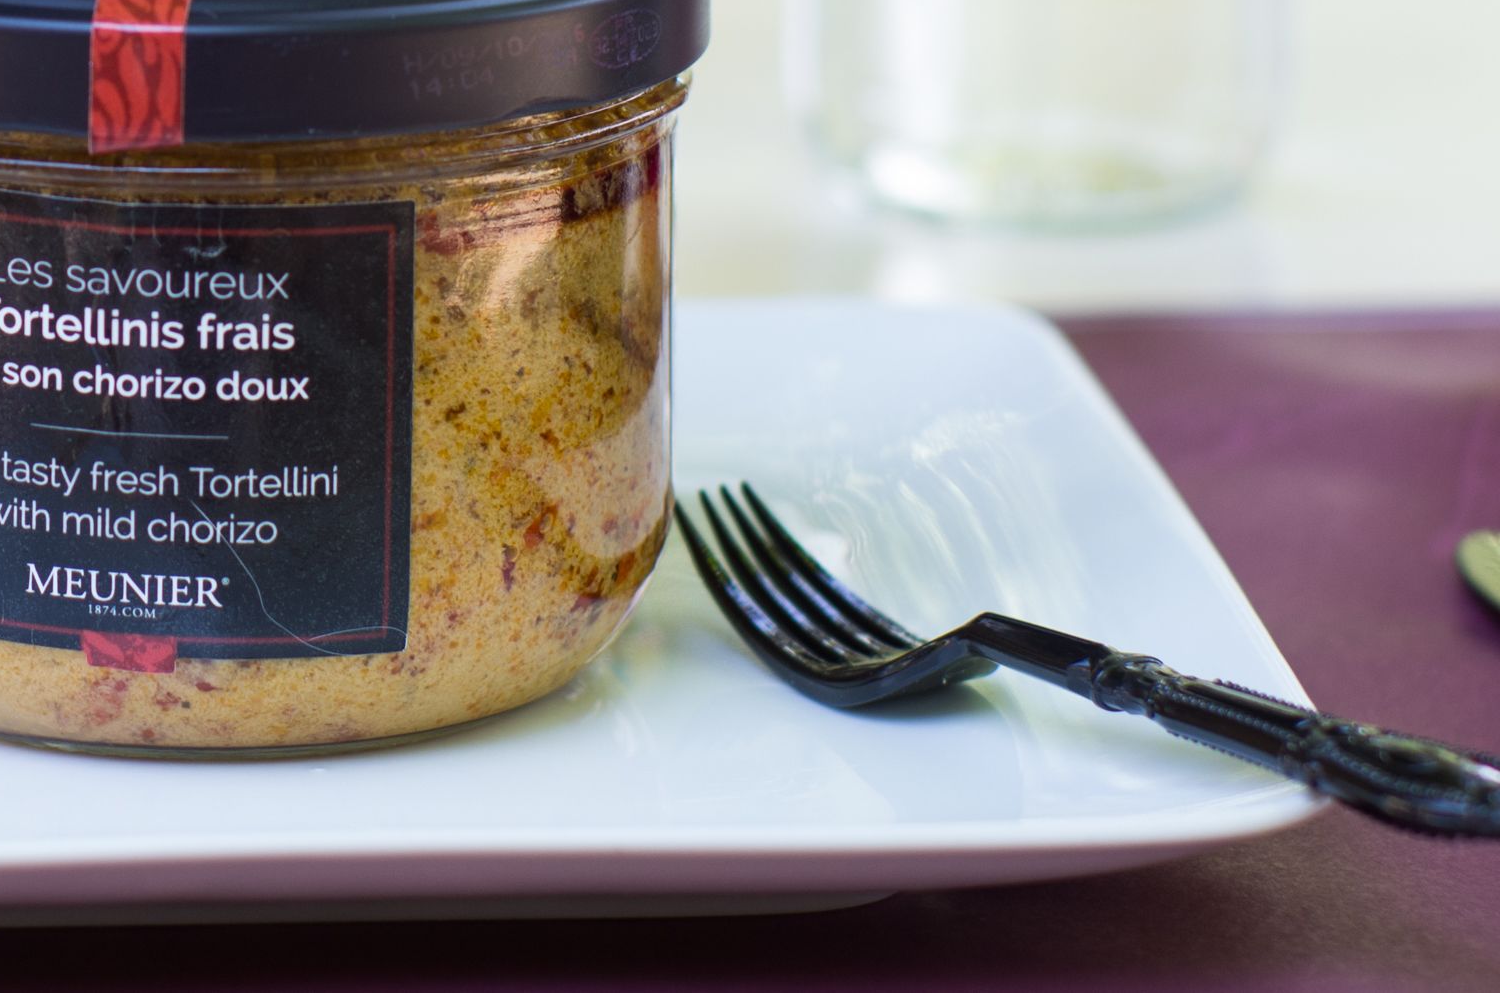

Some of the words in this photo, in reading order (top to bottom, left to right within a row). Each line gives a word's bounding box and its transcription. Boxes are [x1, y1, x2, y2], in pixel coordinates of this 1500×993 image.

[66, 265, 290, 300] savoureux
[196, 312, 295, 351] frais
[2, 360, 62, 390] son
[72, 364, 205, 401] chorizo
[216, 371, 309, 401] doux
[0, 449, 80, 496] tasty
[90, 461, 179, 495] fresh
[189, 466, 338, 498] Tortellini
[62, 507, 136, 540] mild
[147, 512, 277, 545] chorizo
[88, 604, 157, 619] 1874.COM
